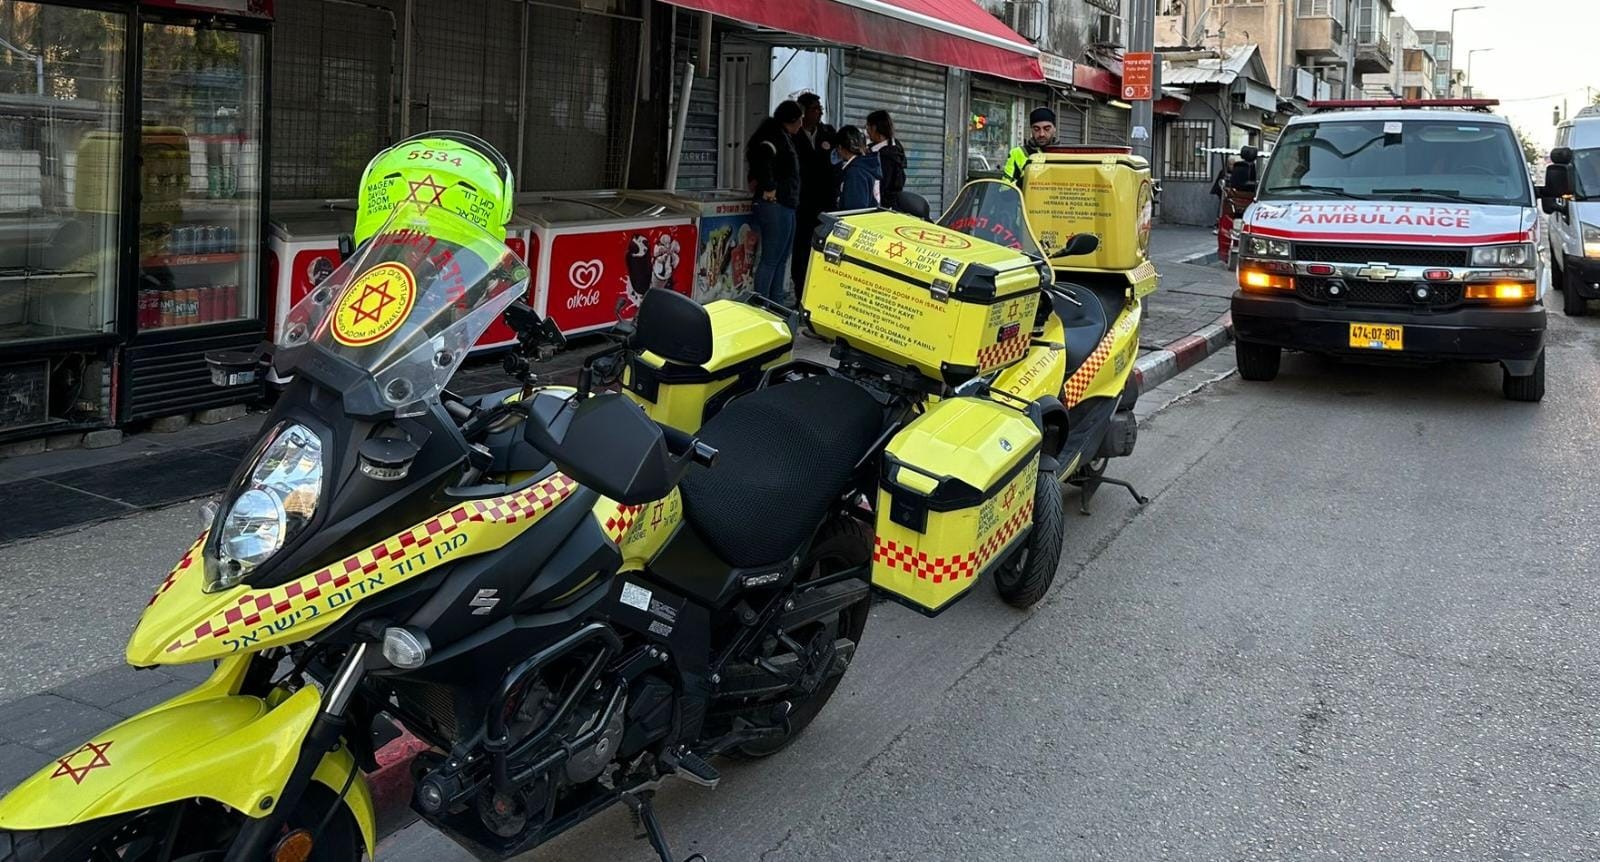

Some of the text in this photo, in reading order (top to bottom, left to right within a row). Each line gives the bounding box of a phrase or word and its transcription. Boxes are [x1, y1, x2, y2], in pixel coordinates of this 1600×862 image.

[407, 150, 462, 167] 5534
[368, 180, 394, 191] MAGEN
[368, 195, 389, 208] ADOM
[1297, 213, 1470, 229] AMBULANCE
[824, 266, 852, 280] CANADIAN
[853, 276, 873, 287] MAGEN
[874, 283, 892, 293] DAVID
[892, 291, 910, 300] ADOM
[924, 301, 946, 313] ISRAEL
[840, 282, 852, 290] OUR
[566, 289, 600, 310] שטראוס
[817, 304, 829, 312] JOE
[836, 311, 856, 321] GLORY
[858, 319, 873, 328] KAYE
[875, 325, 906, 340] GOLDMAN
[913, 340, 936, 351] FAMILY
[848, 304, 880, 319] PRESENTED
[896, 322, 911, 331] LOVE
[862, 327, 878, 337] KAYE
[886, 336, 908, 347] FAMILY
[1018, 366, 1040, 386] אדום
[223, 533, 468, 652] מגן דוד אדום בישראל
